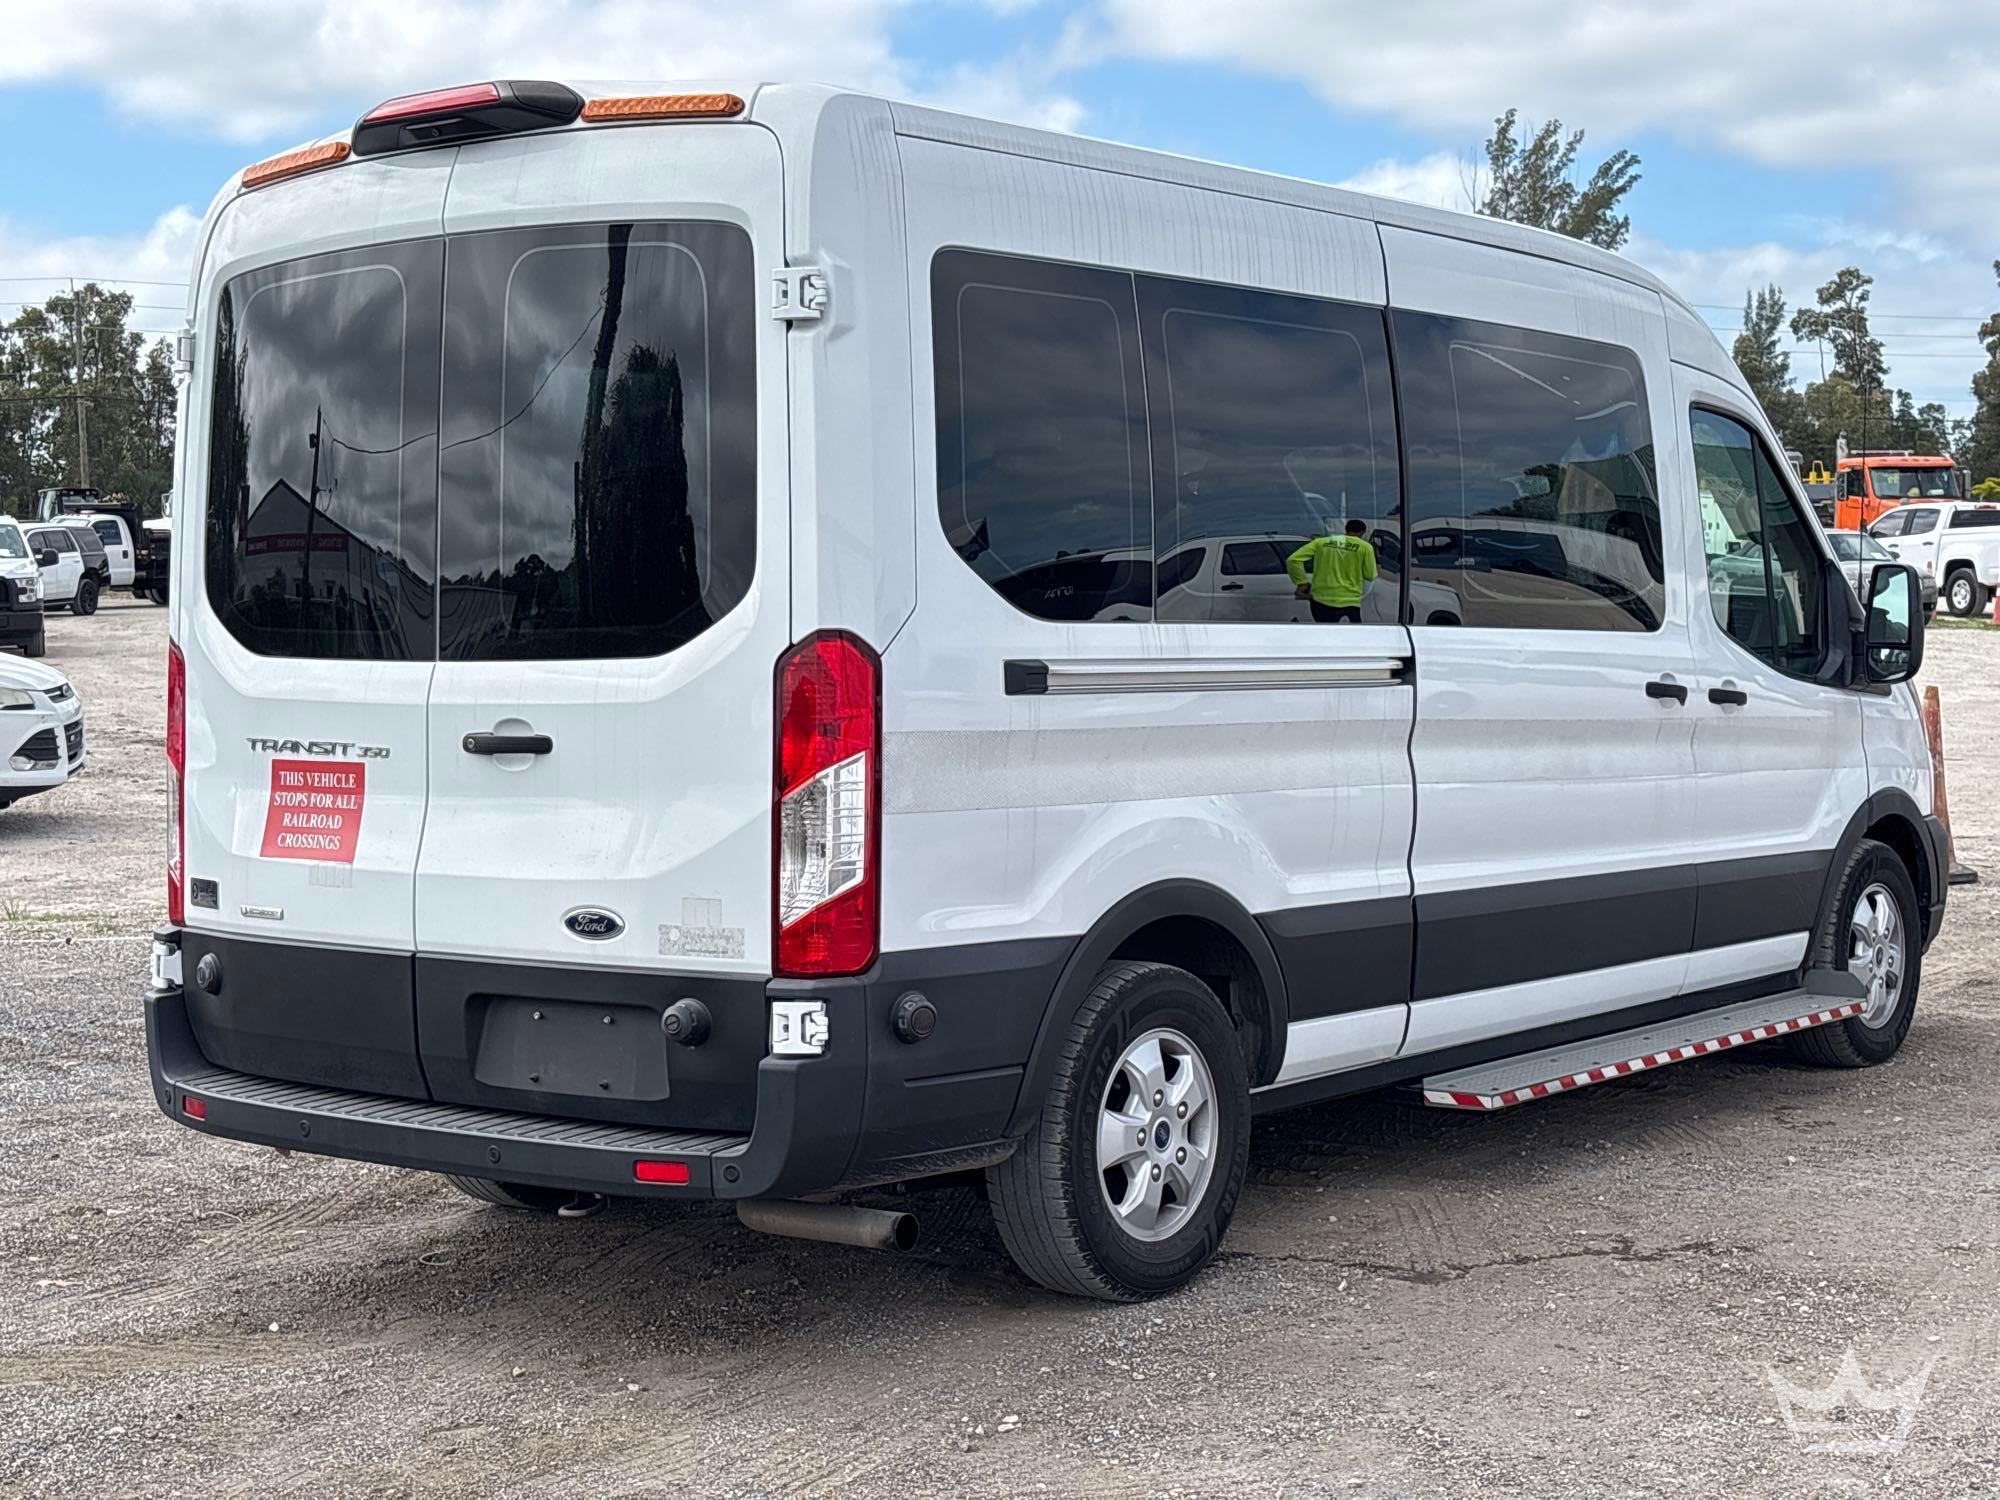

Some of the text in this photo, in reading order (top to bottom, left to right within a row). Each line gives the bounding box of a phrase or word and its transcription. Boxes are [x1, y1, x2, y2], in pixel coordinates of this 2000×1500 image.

[246, 737, 391, 760] TRANSIT 350
[278, 770, 357, 789] THIS VEHICLE
[273, 791, 359, 810] STOPS FOR ALL
[282, 812, 343, 830] RAILROAD
[277, 832, 342, 851] CROSSINGS
[574, 914, 609, 932] Ford
